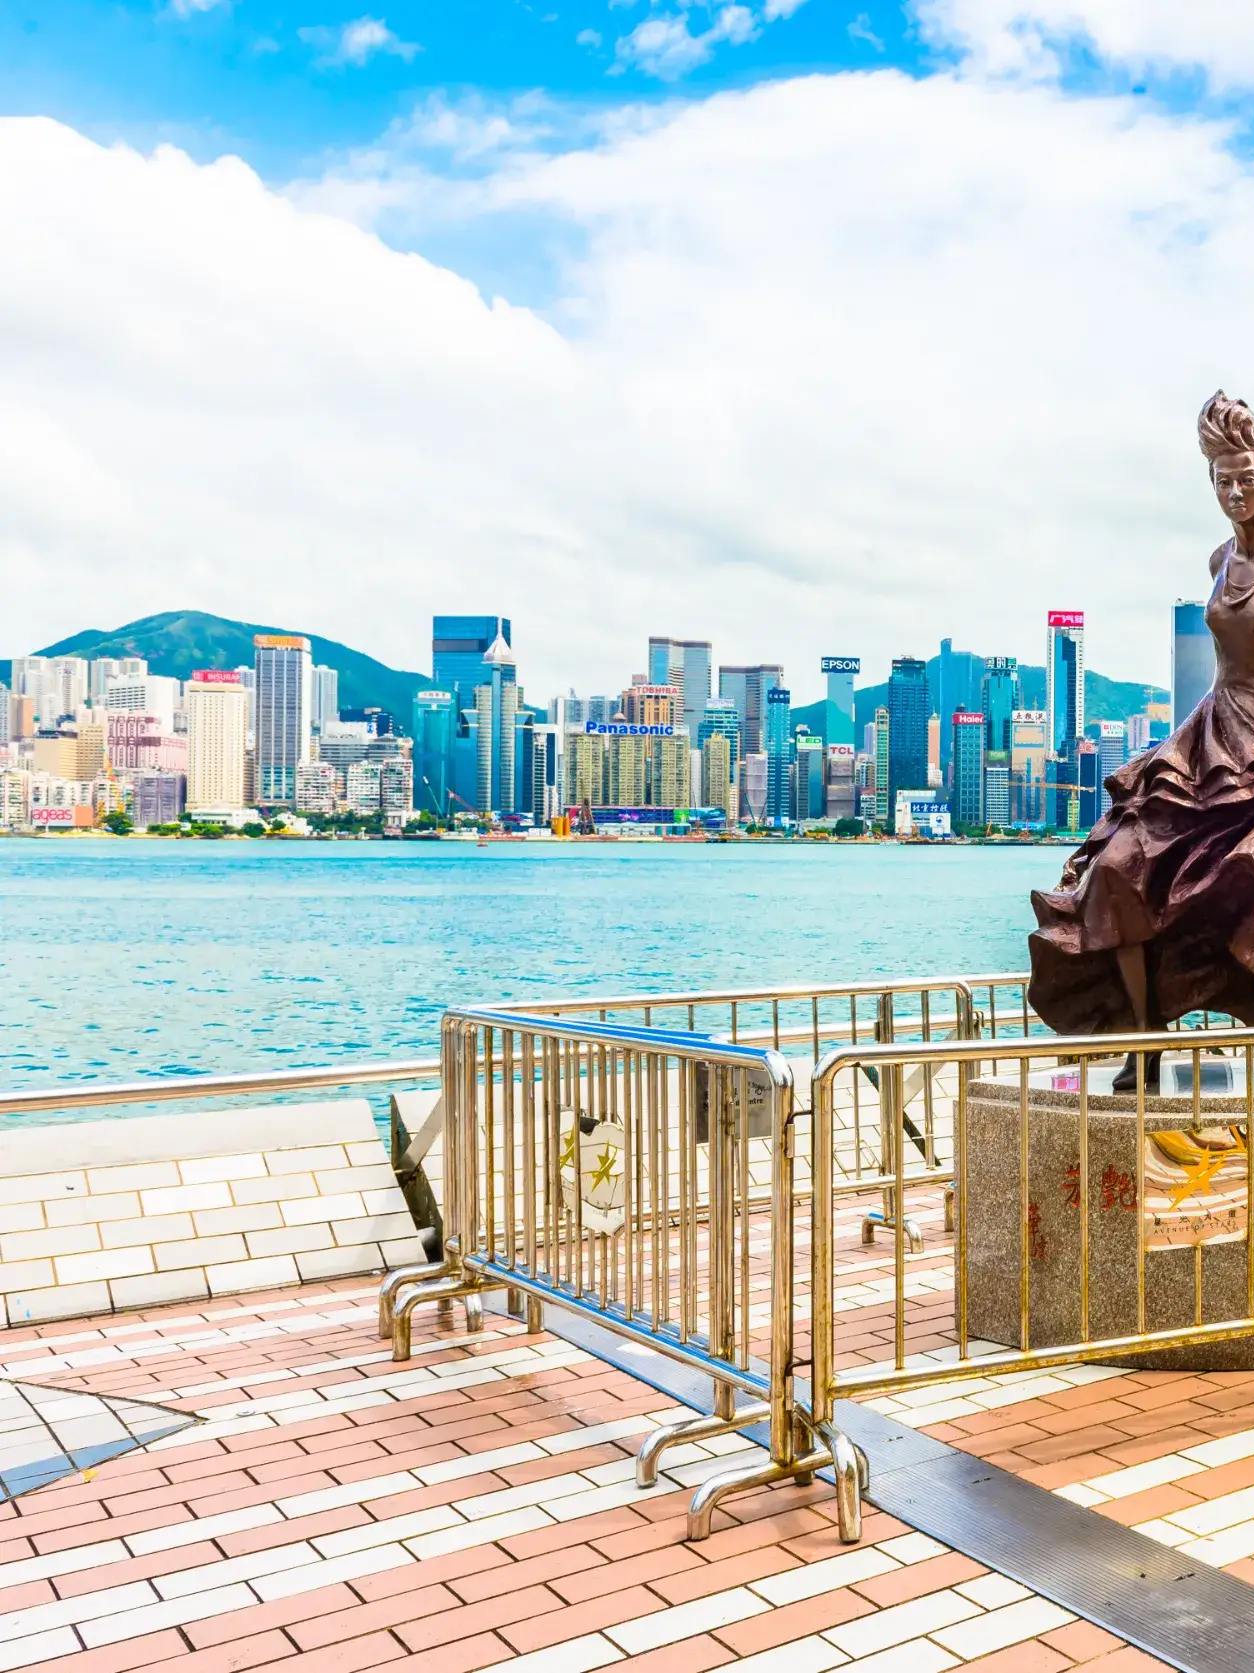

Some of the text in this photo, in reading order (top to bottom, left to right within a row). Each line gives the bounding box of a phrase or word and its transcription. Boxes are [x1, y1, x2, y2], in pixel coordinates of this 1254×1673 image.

[821, 660, 860, 670] EPSON
[636, 686, 678, 694] TOSHIBA
[959, 714, 983, 723] Haier
[585, 721, 674, 735] Panasonic
[829, 746, 854, 755] TCL
[32, 808, 72, 824] ageas
[1153, 1226, 1190, 1235] AVENUE
